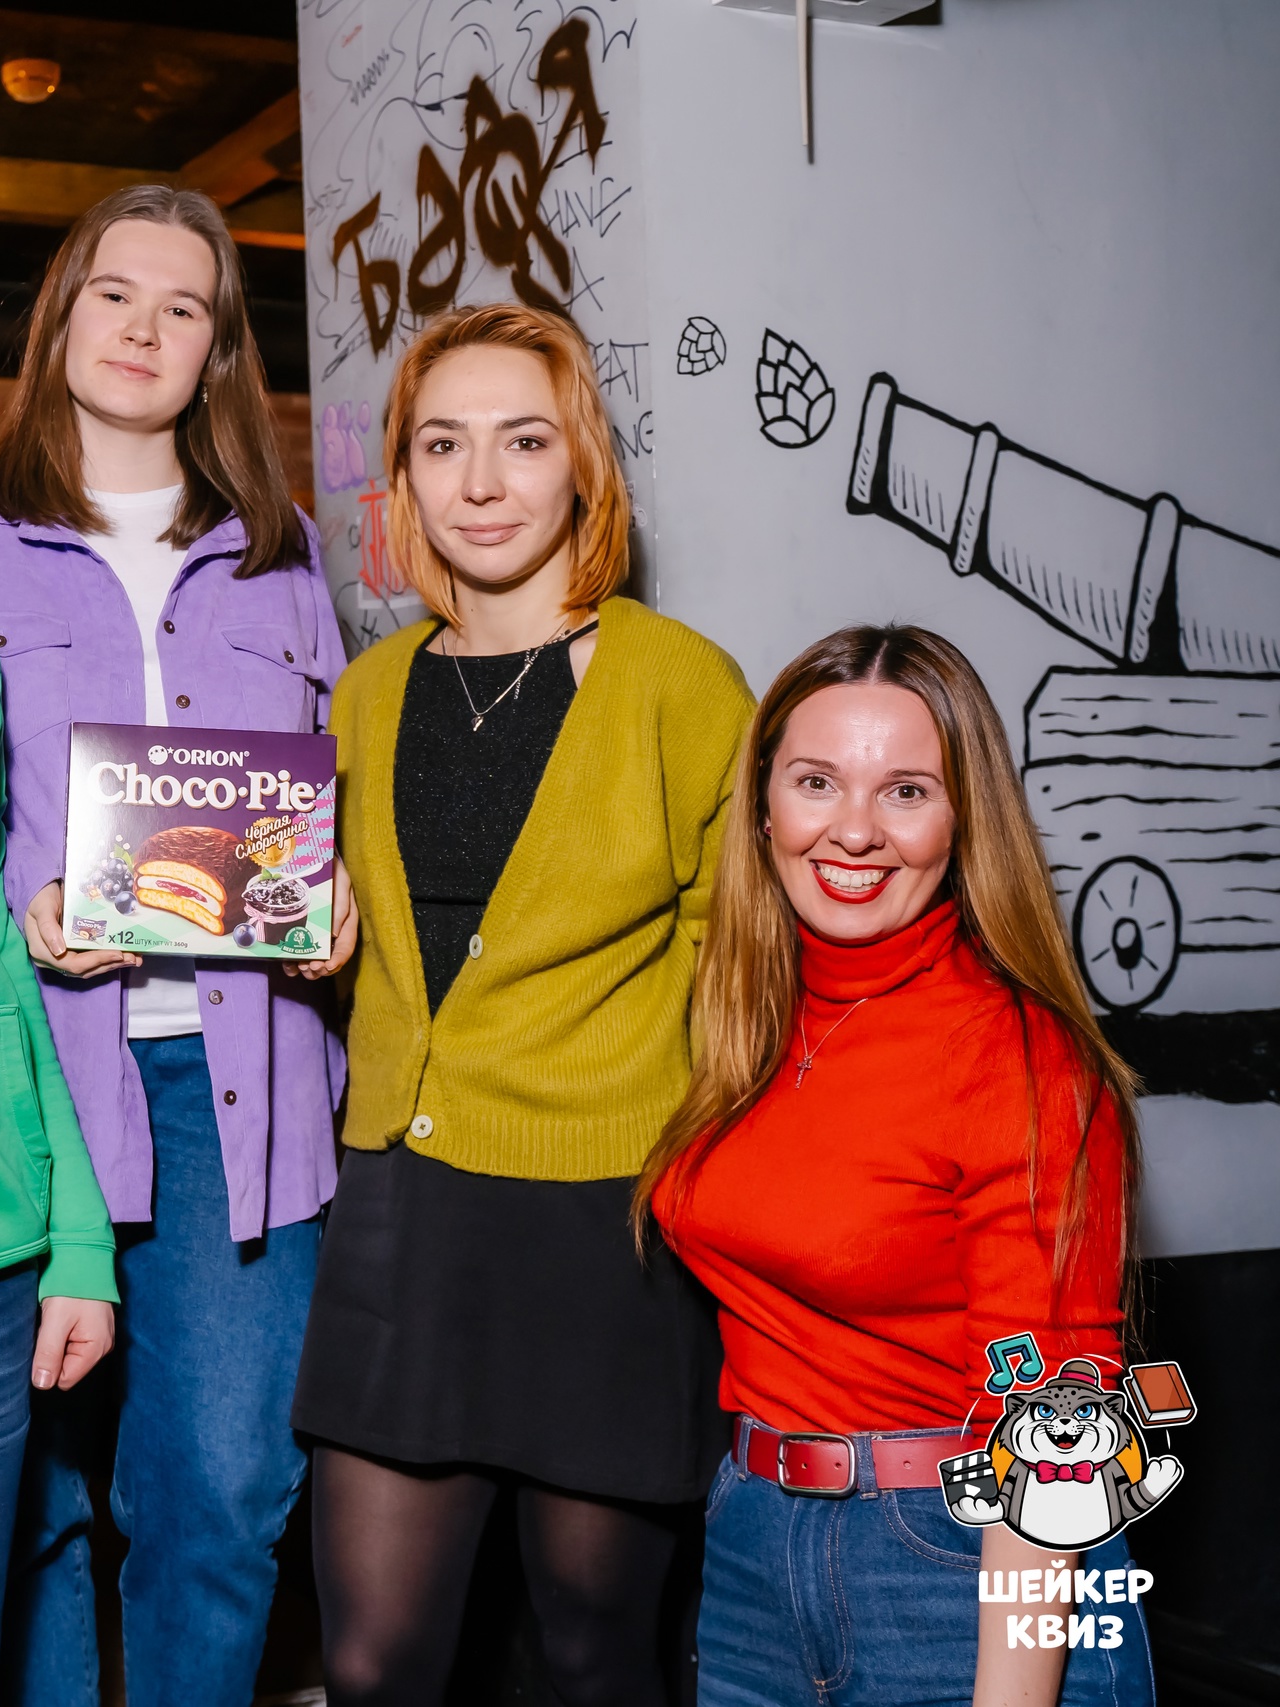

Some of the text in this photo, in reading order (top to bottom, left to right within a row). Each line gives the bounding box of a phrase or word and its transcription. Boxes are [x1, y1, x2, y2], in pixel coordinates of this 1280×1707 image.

[540, 177, 632, 238] HAVE
[173, 748, 244, 767] ORION
[235, 820, 308, 859] Смородина
[245, 815, 291, 840] Чёрная
